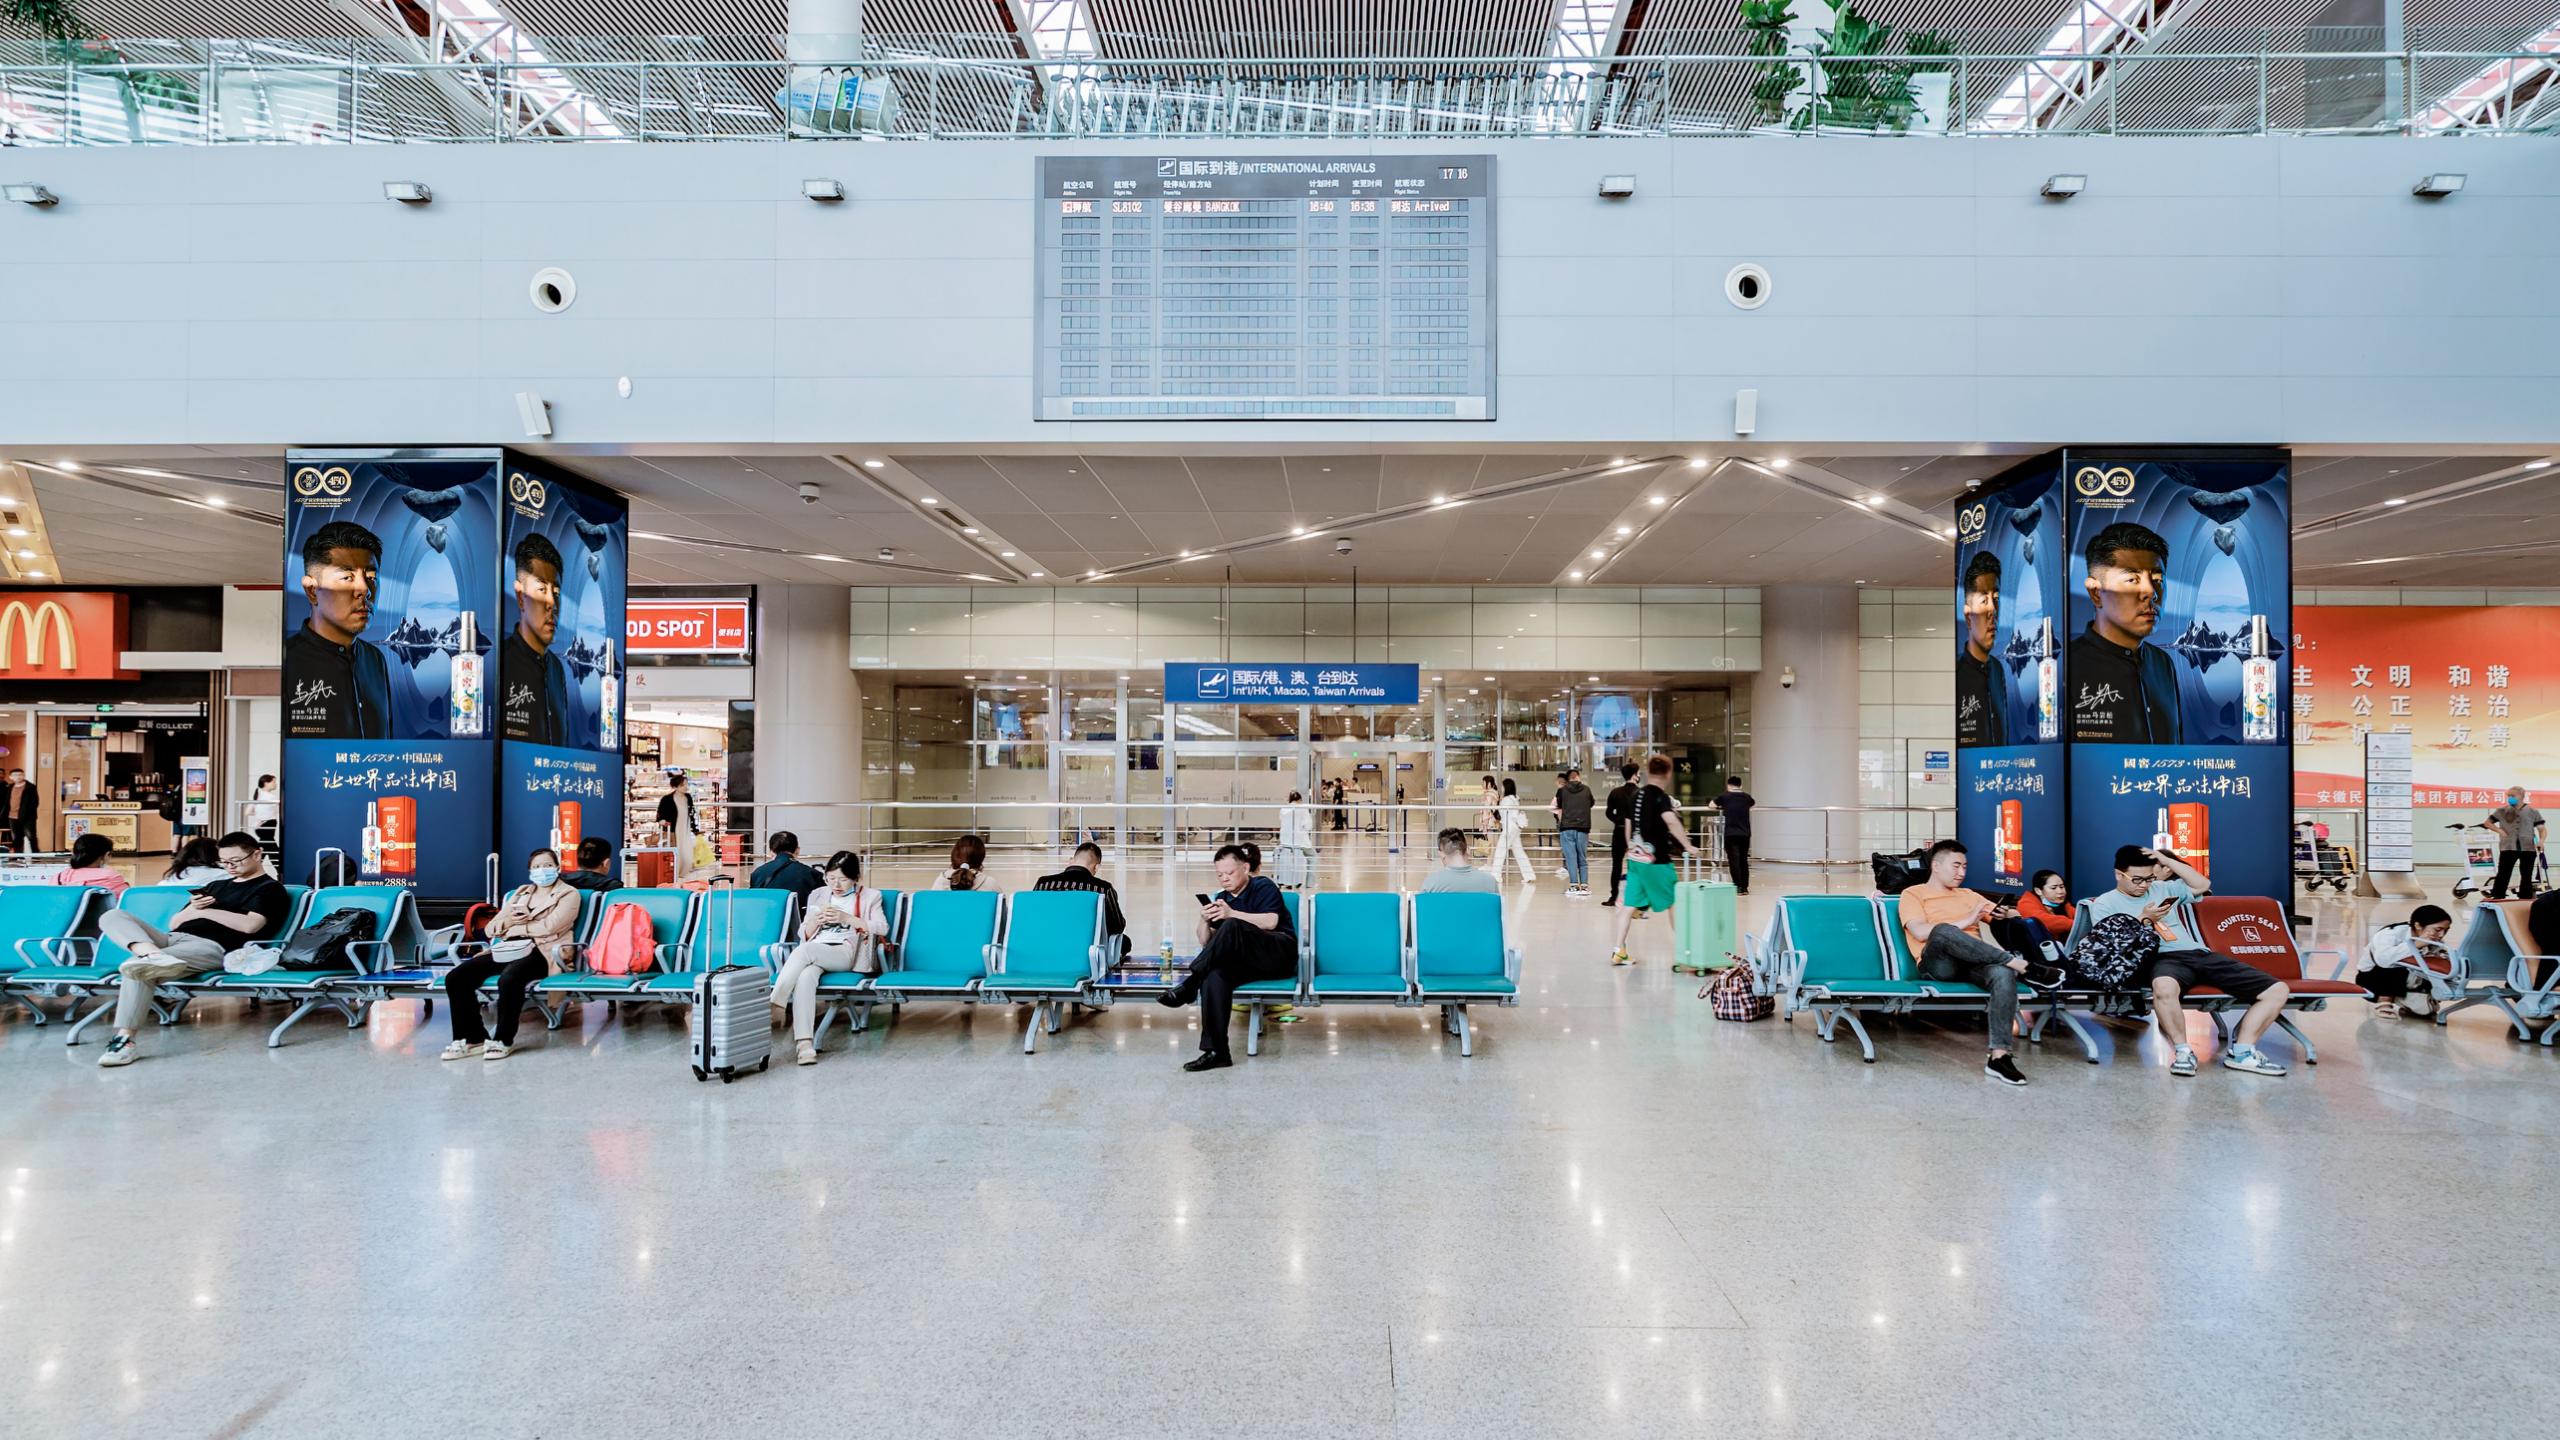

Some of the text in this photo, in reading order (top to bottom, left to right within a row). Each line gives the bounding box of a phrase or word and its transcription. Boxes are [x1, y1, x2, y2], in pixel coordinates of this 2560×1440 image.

[1325, 162, 1376, 174] ARRIVALS
[626, 620, 705, 638] OD SPOT
[2351, 665, 2412, 688] 文明
[2448, 665, 2510, 688] 和谐
[1273, 686, 1310, 697] Macao,
[1312, 686, 1347, 697] Taiwan
[1348, 686, 1385, 697] Arrivals
[2351, 694, 2412, 717] 公正
[2448, 694, 2510, 718] 法治
[322, 767, 457, 792] 让世界品味中国
[2110, 773, 2251, 798] 让世界品味中国
[384, 878, 407, 887] 2888
[2217, 914, 2280, 932] COURTESY SEAT
